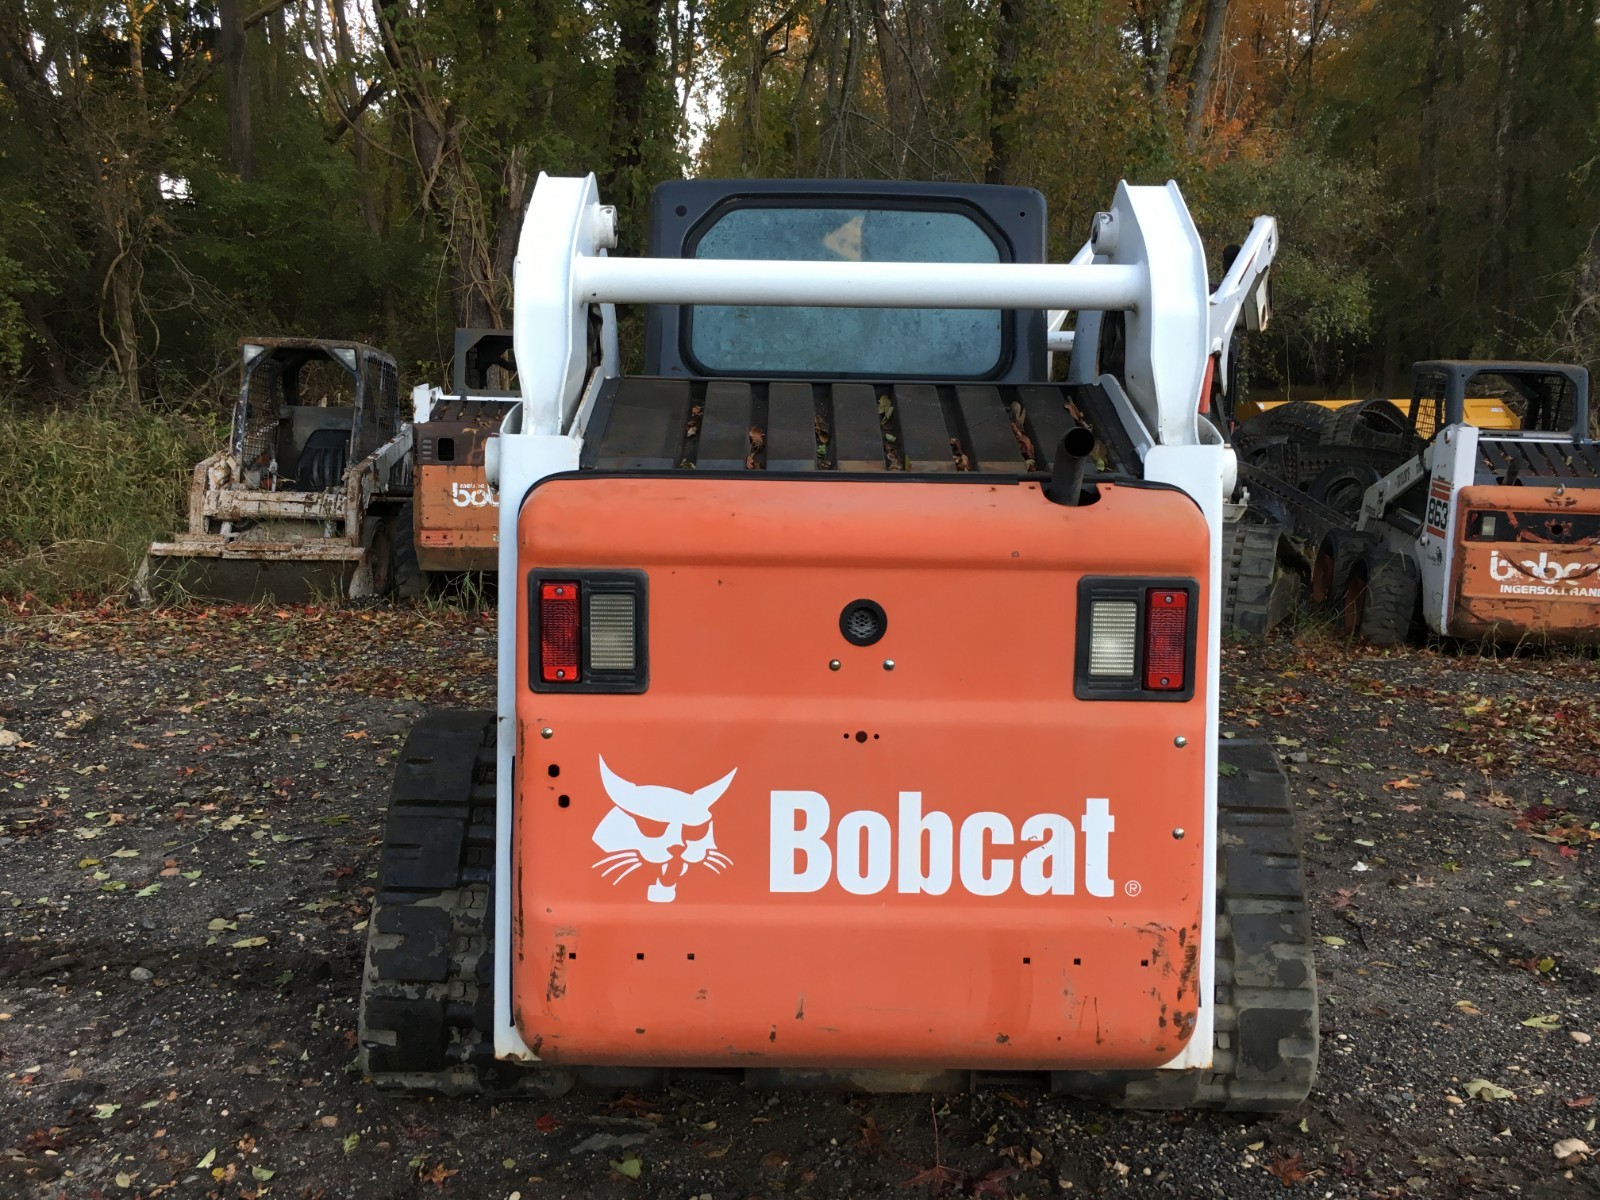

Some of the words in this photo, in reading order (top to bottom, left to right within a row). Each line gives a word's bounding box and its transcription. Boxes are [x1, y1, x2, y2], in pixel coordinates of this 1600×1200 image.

[1427, 497, 1449, 530] 863
[1500, 584, 1568, 596] INGERSOLL
[769, 790, 1115, 898] Bobcat
